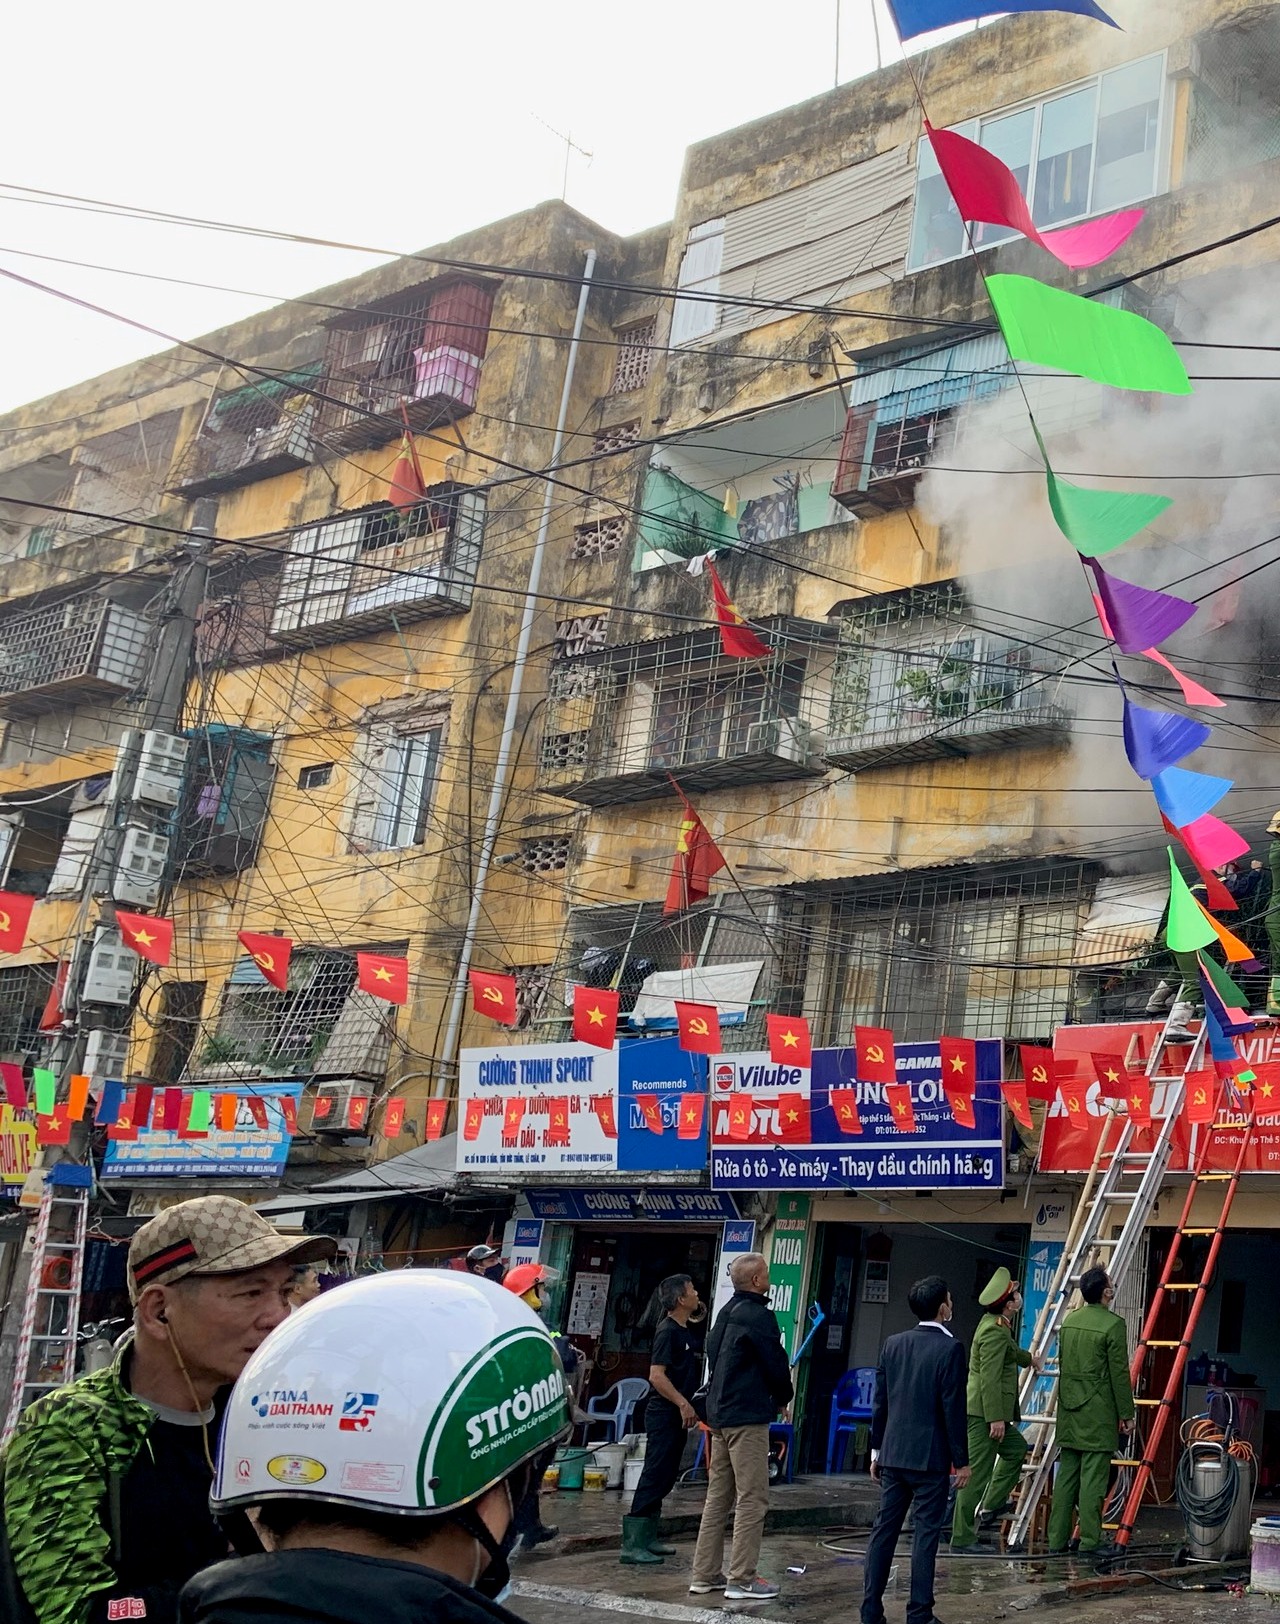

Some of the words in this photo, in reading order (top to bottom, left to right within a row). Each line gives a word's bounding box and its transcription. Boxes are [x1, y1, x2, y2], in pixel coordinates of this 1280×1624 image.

[479, 1054, 517, 1086] CƯỜNG
[519, 1057, 551, 1090] THỊNH
[556, 1056, 594, 1083] SPORT
[739, 1065, 802, 1087] Vilube
[632, 1080, 687, 1090] Recommends
[1274, 1136, 1280, 1144] 5
[715, 1154, 740, 1178] Rửa
[744, 1158, 751, 1178] ô
[754, 1157, 768, 1178] tô
[780, 1159, 797, 1178] Xe
[800, 1158, 829, 1181] máy
[840, 1157, 875, 1180] Thay
[878, 1151, 905, 1176] dầu
[909, 1153, 950, 1176] chính
[678, 1195, 724, 1210] SPORT
[773, 1238, 801, 1265] MUA
[767, 1279, 793, 1312] BÁN
[513, 1424, 527, 1437] CAO
